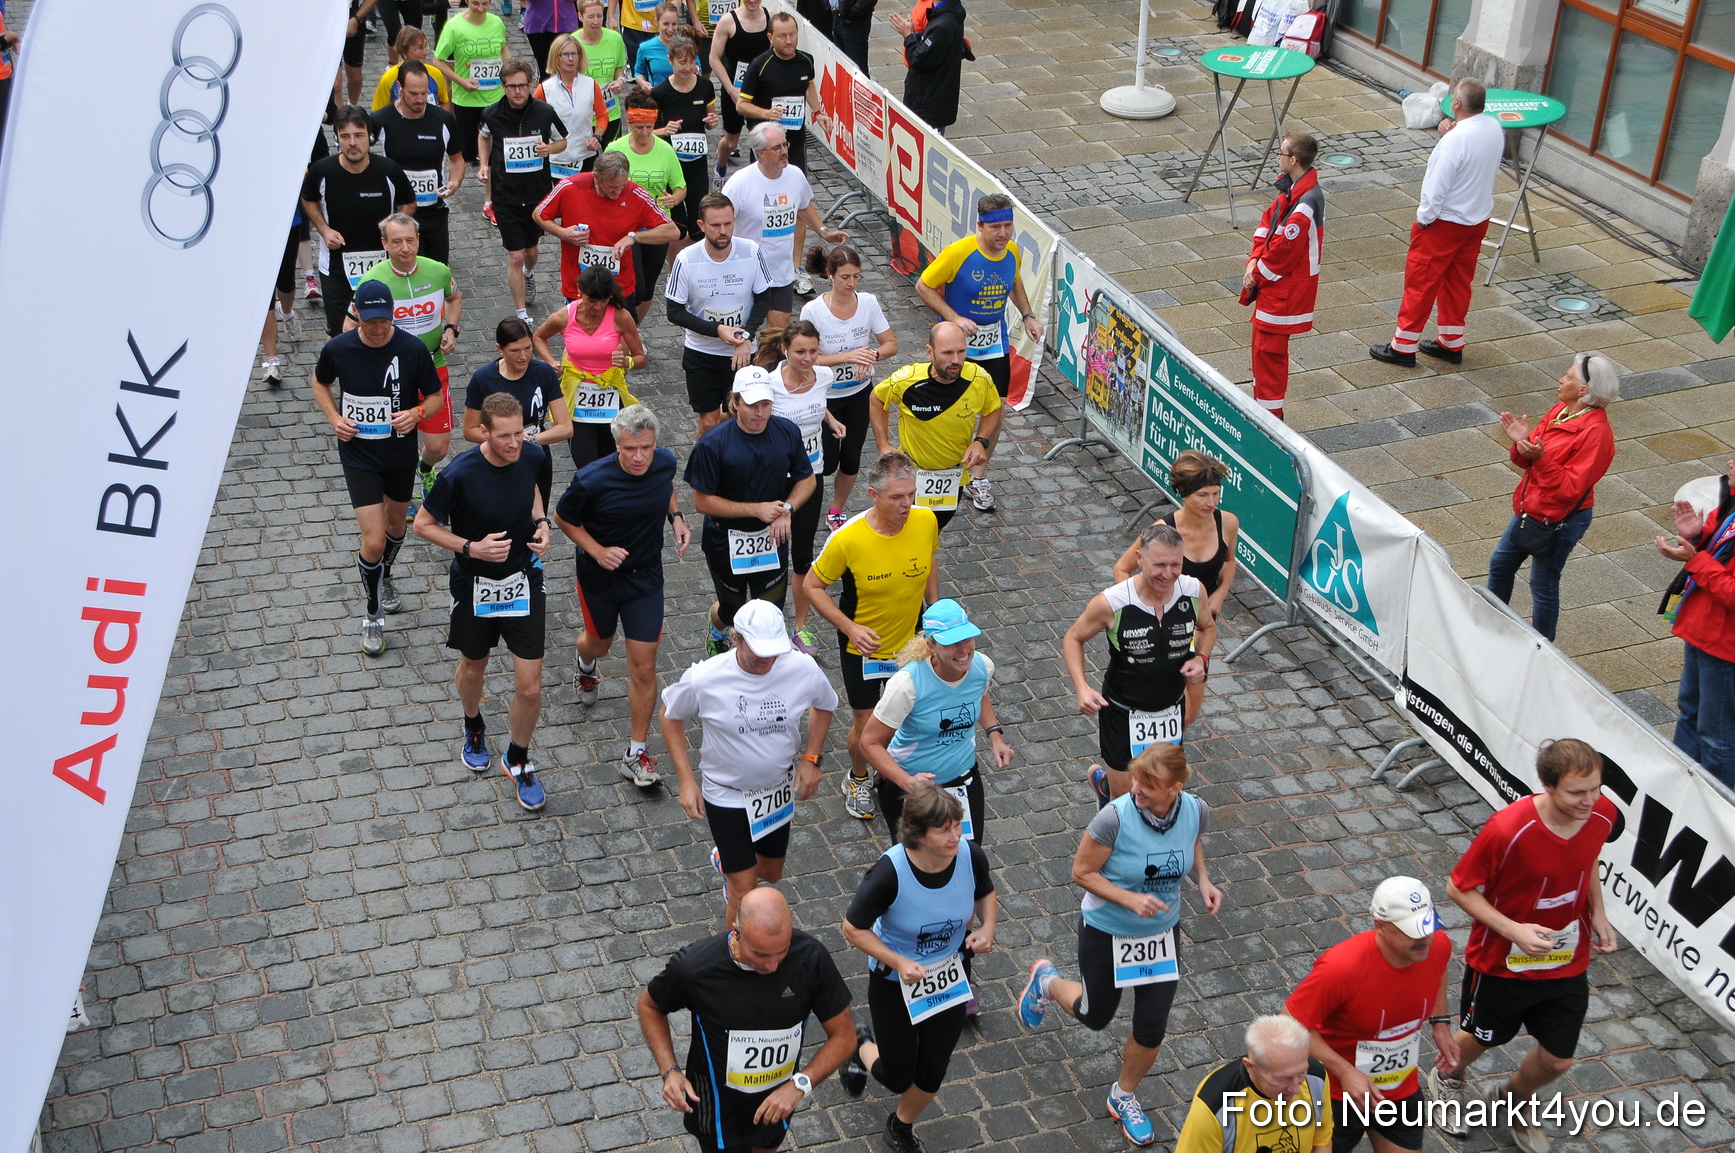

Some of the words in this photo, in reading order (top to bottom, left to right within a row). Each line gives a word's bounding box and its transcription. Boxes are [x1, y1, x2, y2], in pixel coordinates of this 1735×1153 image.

[711, 2, 737, 14] 2579
[474, 66, 500, 78] 2372
[509, 145, 539, 160] 2319
[676, 142, 704, 154] 2448
[410, 179, 434, 193] 256
[766, 210, 795, 228] 3329
[582, 252, 616, 270] 3348
[968, 330, 998, 347] 2235
[578, 392, 615, 408] 2487
[912, 404, 931, 412] Bernd
[1174, 374, 1242, 442] Event-Leit-Systeme
[346, 404, 386, 422] 2584
[584, 410, 606, 418] Renate
[1152, 396, 1181, 436] Mehr
[96, 328, 189, 539] BKK
[356, 425, 378, 434] ochen
[1150, 422, 1166, 452] für
[1147, 456, 1163, 480] Miet
[1164, 473, 1170, 486] &
[924, 478, 952, 494] 292
[928, 498, 944, 506] Bernd
[736, 534, 772, 556] 2328
[1237, 542, 1256, 567] 6352
[867, 572, 893, 581] Dieter
[480, 582, 525, 603] 2132
[490, 602, 515, 612] Robert
[1304, 588, 1333, 616] Gebäude
[1333, 609, 1358, 634] Service
[1358, 628, 1379, 651] GmbH
[52, 576, 147, 806] Audi
[750, 724, 787, 733] Neumarkter
[1135, 718, 1178, 741] 3410
[1456, 734, 1473, 754] die
[752, 784, 791, 819] 2706
[762, 812, 786, 828] Werner
[1599, 858, 1700, 972] dtwerke
[1120, 938, 1168, 964] 2301
[1548, 953, 1572, 962] Xaver
[1139, 966, 1154, 976] Pia
[908, 963, 960, 1000] 2586
[927, 993, 950, 1008] Silvia
[730, 1034, 757, 1044] PARTL
[758, 1034, 792, 1044] Neumarkt
[1474, 1026, 1493, 1042] 53
[1358, 1044, 1383, 1053] PARTL
[744, 1044, 789, 1070] 200
[1370, 1048, 1410, 1073] 253
[744, 1069, 783, 1085] Matthias
[1374, 1073, 1399, 1084] Mario
